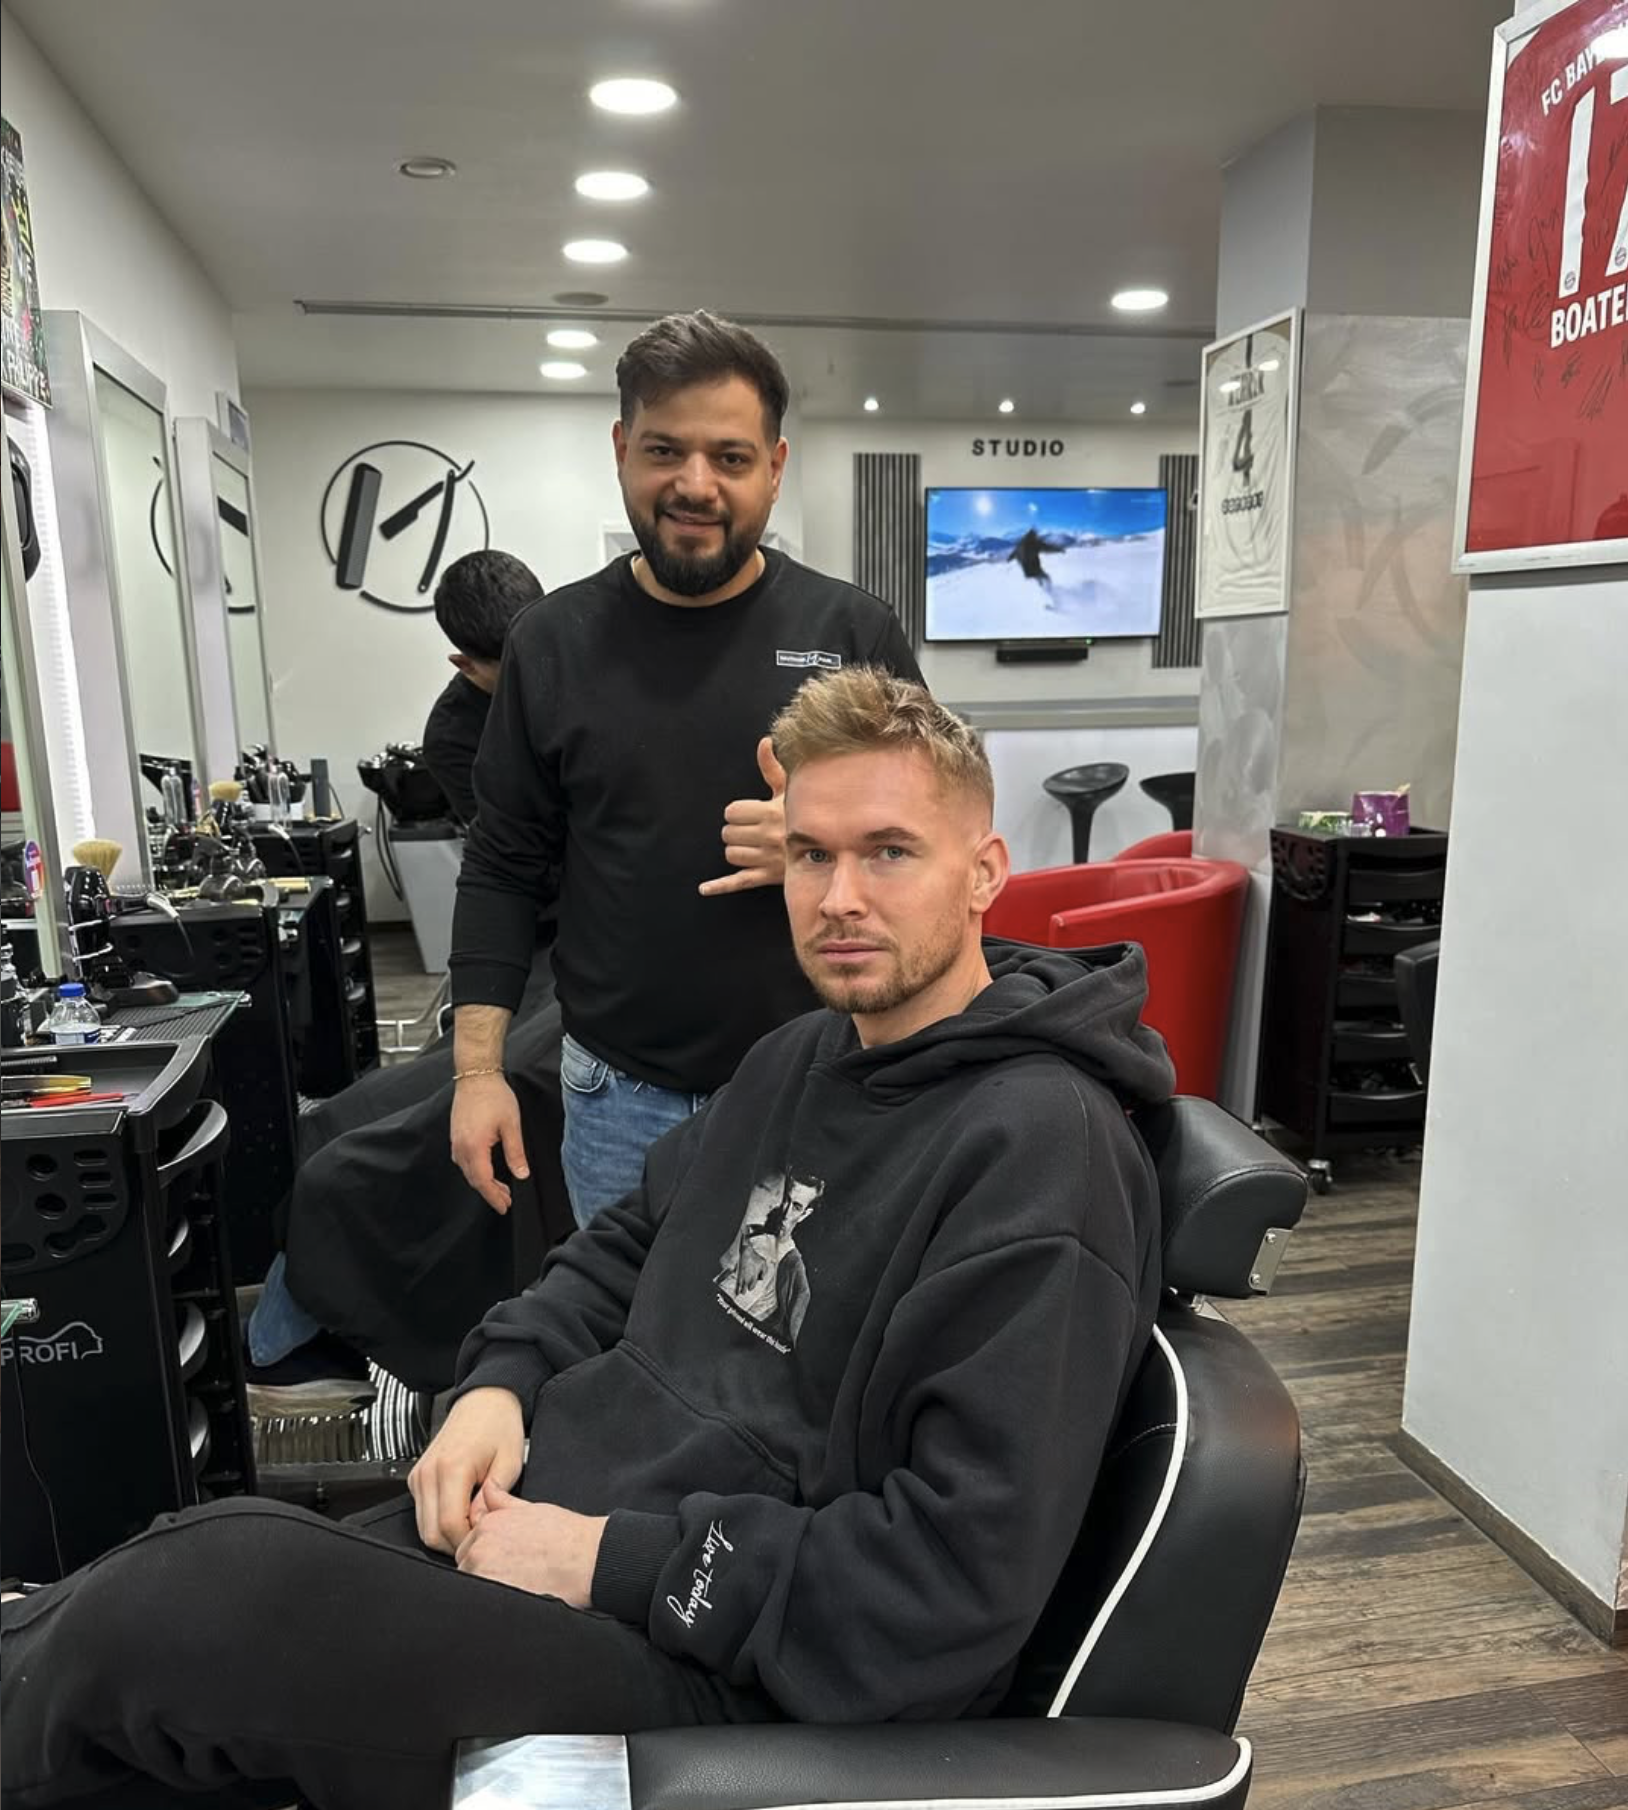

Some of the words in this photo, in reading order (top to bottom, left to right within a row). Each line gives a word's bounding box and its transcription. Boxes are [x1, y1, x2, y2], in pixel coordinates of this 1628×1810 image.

[1541, 78, 1563, 116] FC
[1550, 281, 1628, 349] BOATE
[971, 439, 1065, 457] STUDIO
[1232, 408, 1255, 488] 4
[0, 1341, 78, 1366] PROFI
[702, 1519, 734, 1568] Live
[666, 1568, 714, 1629] today
